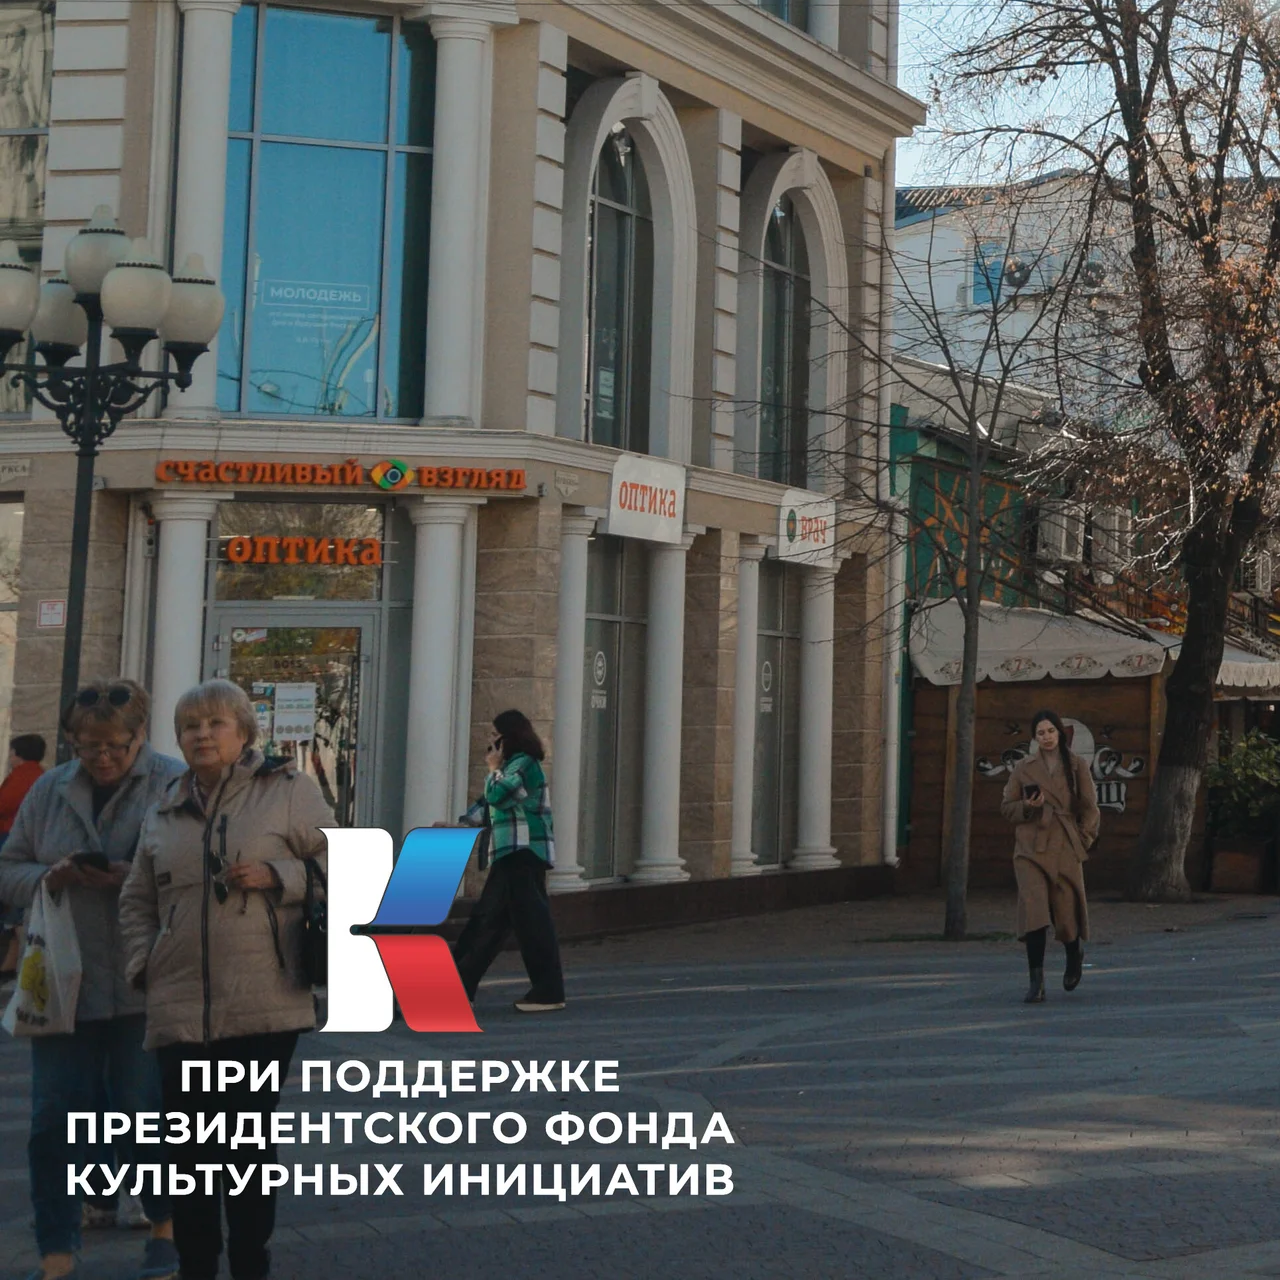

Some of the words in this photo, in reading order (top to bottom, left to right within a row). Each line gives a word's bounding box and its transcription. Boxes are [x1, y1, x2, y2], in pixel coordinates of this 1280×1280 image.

[270, 287, 362, 302] МОЛОДЕЖЬ
[156, 458, 364, 484] счастливый
[419, 467, 526, 489] взгляд
[227, 535, 382, 566] оптика
